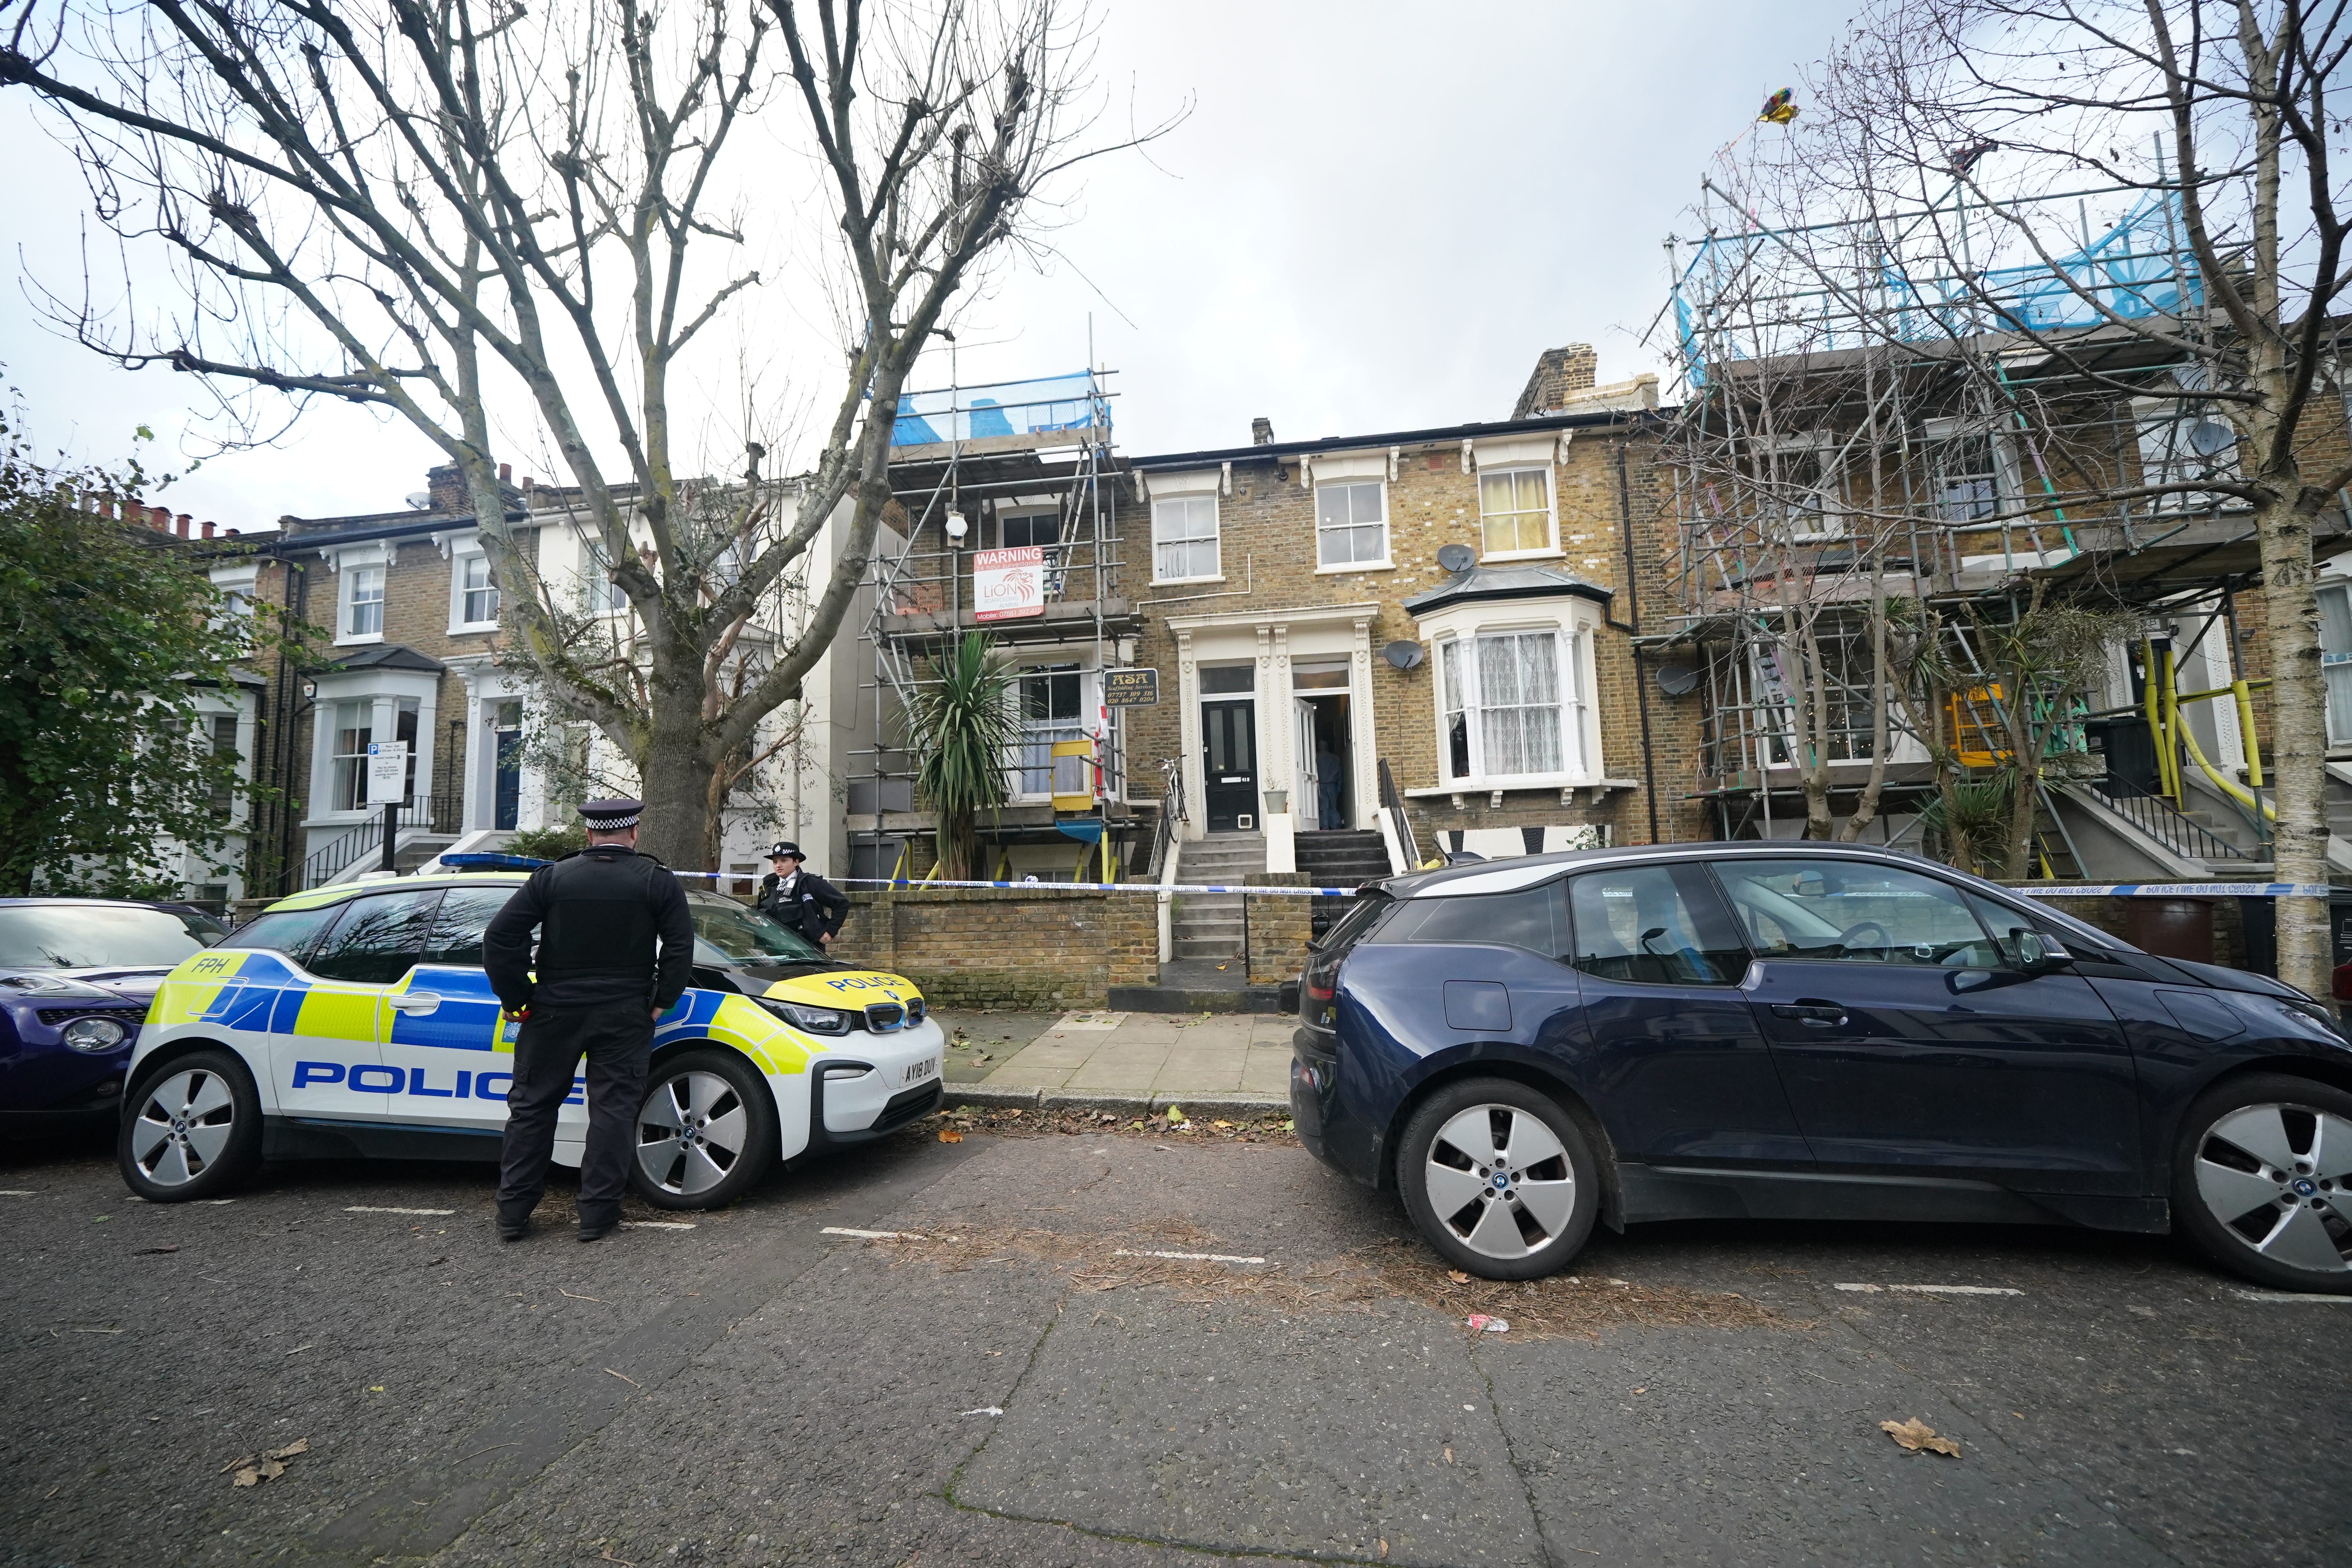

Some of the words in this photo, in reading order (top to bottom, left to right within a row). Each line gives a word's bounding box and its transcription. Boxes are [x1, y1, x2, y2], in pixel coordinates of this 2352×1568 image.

[976, 548, 1041, 565] WARNING
[1003, 561, 1041, 569] surveillance
[1112, 673, 1148, 685] ASA
[191, 958, 230, 973] FPH
[826, 976, 905, 992] POLICE
[906, 1062, 923, 1082] AY18
[924, 1056, 936, 1076] DUV
